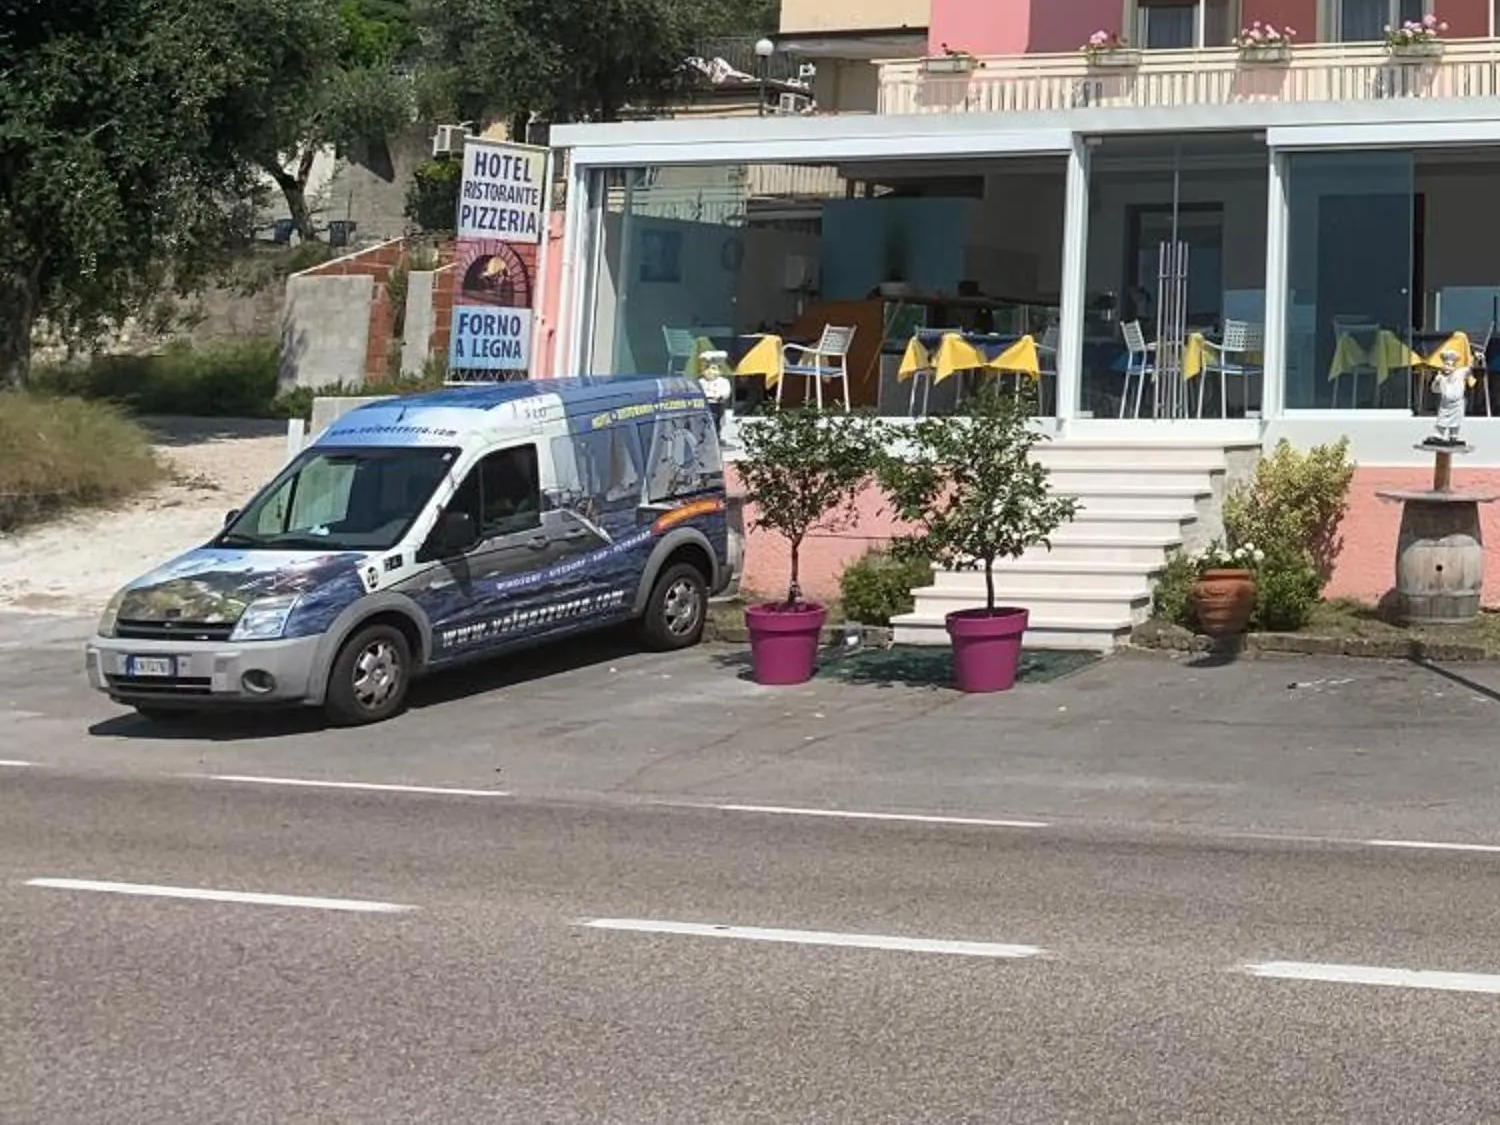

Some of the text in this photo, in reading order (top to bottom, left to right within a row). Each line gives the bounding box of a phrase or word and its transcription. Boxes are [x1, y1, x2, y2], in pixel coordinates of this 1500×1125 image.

[474, 151, 532, 183] HOTEL
[464, 181, 539, 206] RISTORANTE
[461, 205, 537, 234] PIZZERIA
[458, 313, 521, 336] FORNO
[455, 338, 521, 359] A LEGNA
